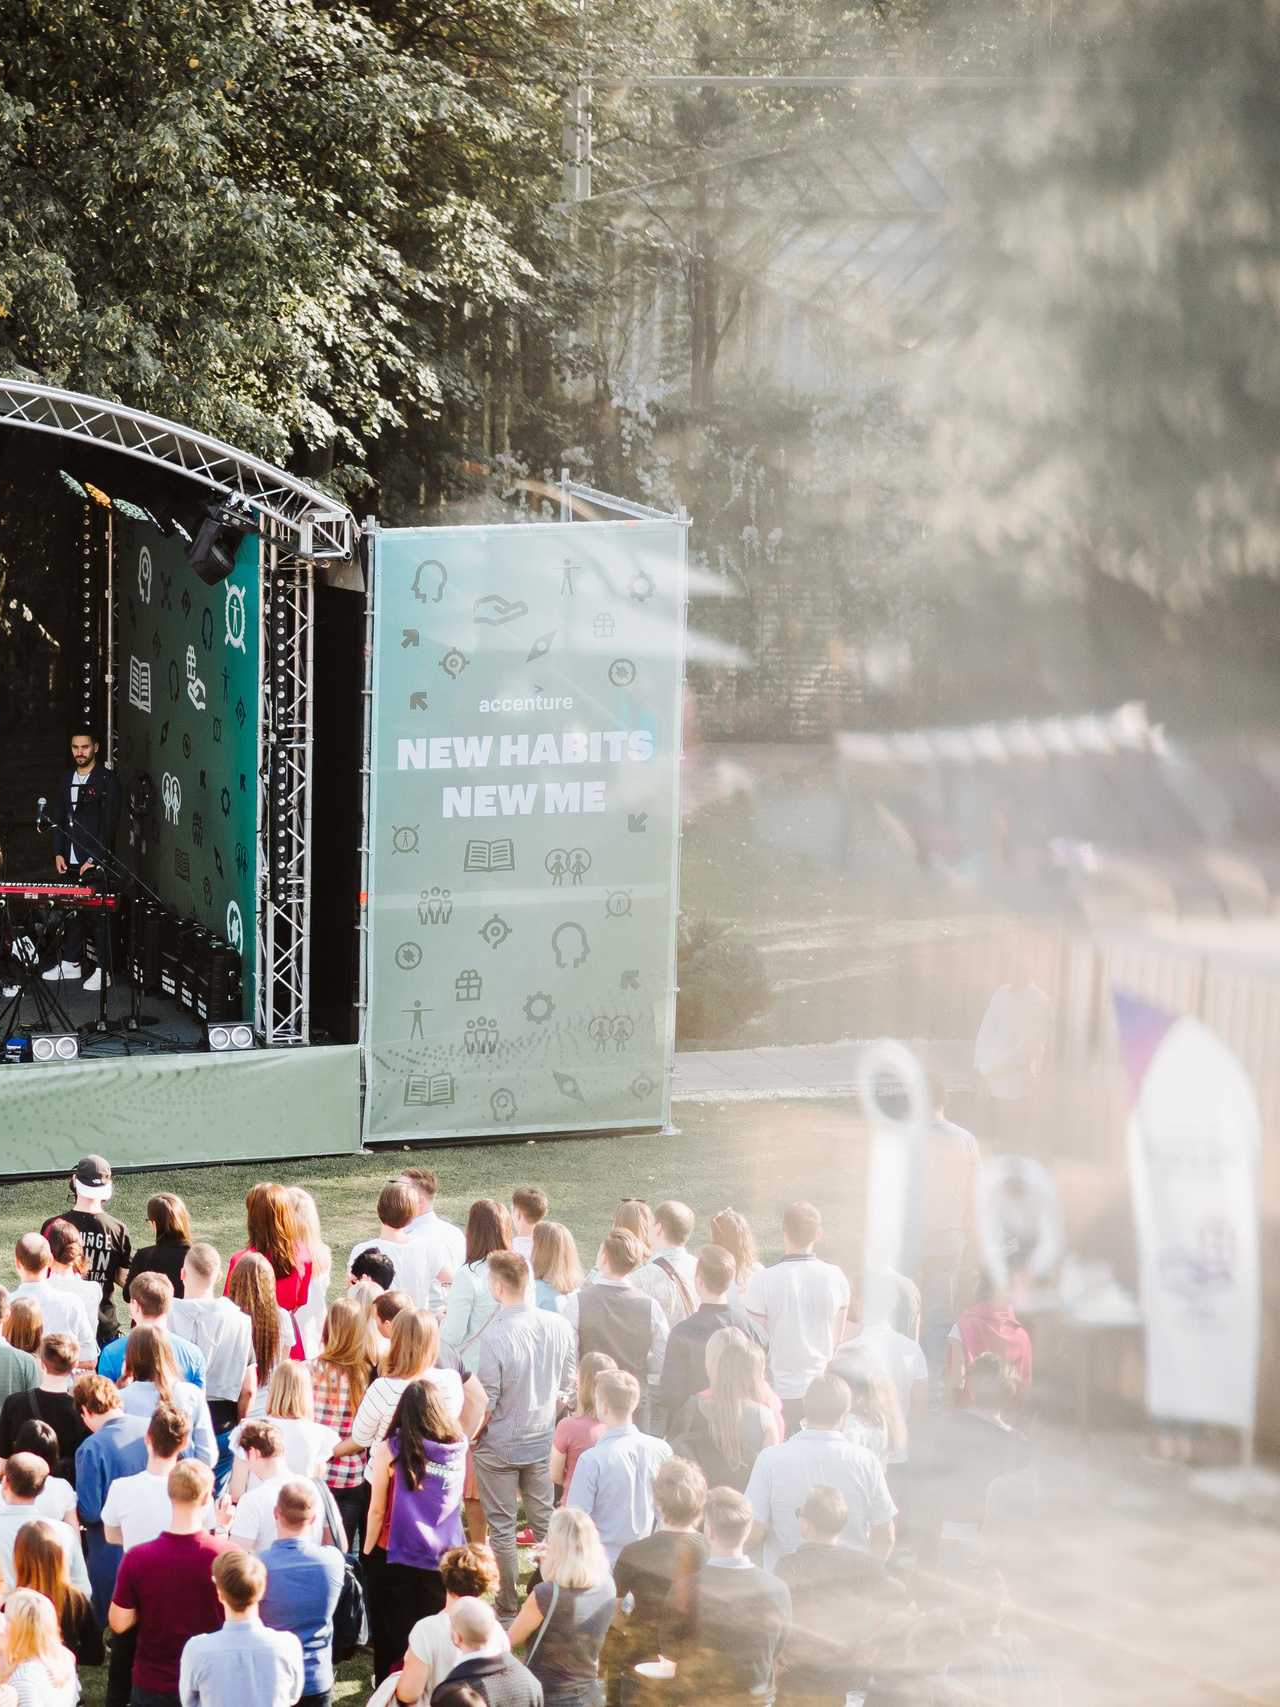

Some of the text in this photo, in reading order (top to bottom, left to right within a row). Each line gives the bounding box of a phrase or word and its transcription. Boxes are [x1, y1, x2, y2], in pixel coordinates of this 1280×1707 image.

[479, 694, 573, 713] accenture
[397, 730, 654, 770] NEW HABITS
[442, 781, 606, 818] NEW ME
